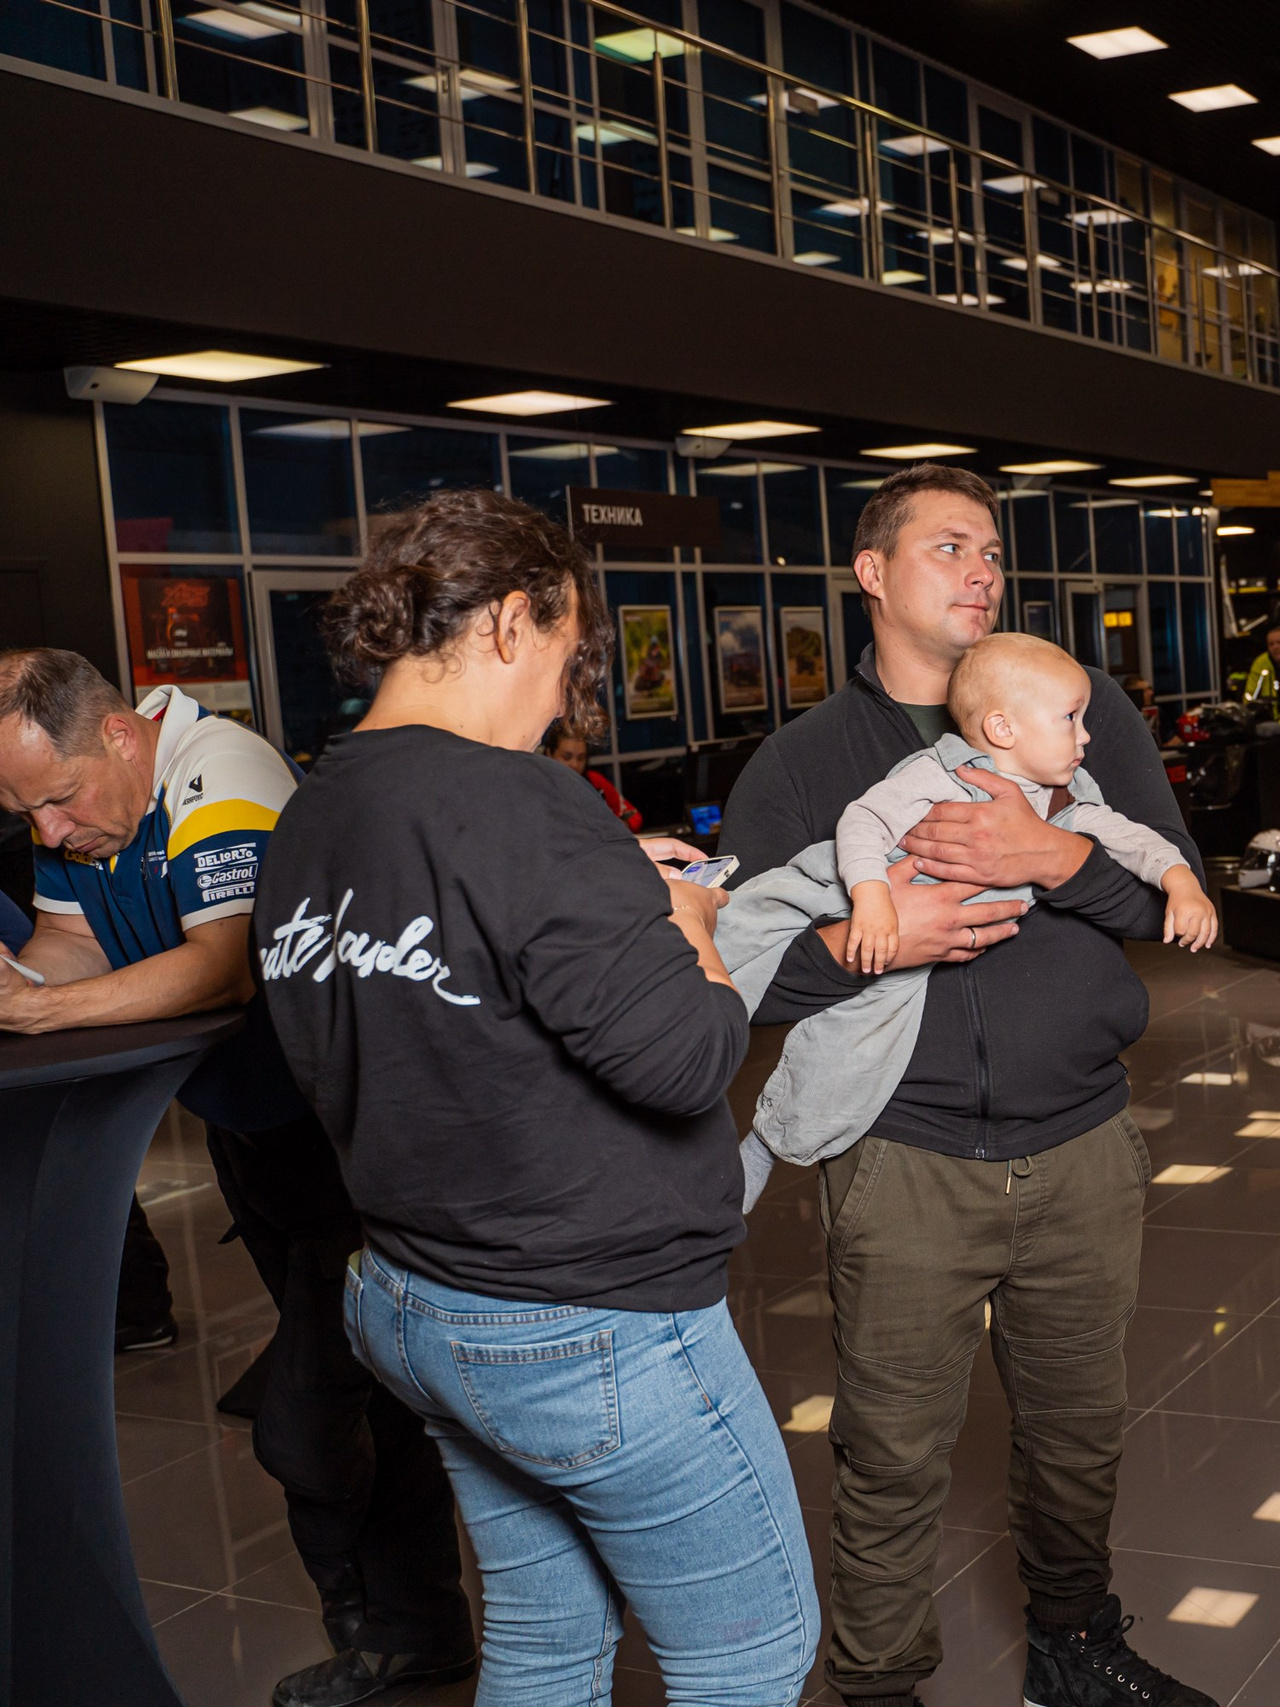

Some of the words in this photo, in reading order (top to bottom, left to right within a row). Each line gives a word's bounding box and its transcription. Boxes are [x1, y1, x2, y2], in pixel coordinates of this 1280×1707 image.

[582, 503, 643, 527] ТЕХНИКА
[211, 866, 255, 885] Castrol
[202, 881, 255, 903] PIRELLI
